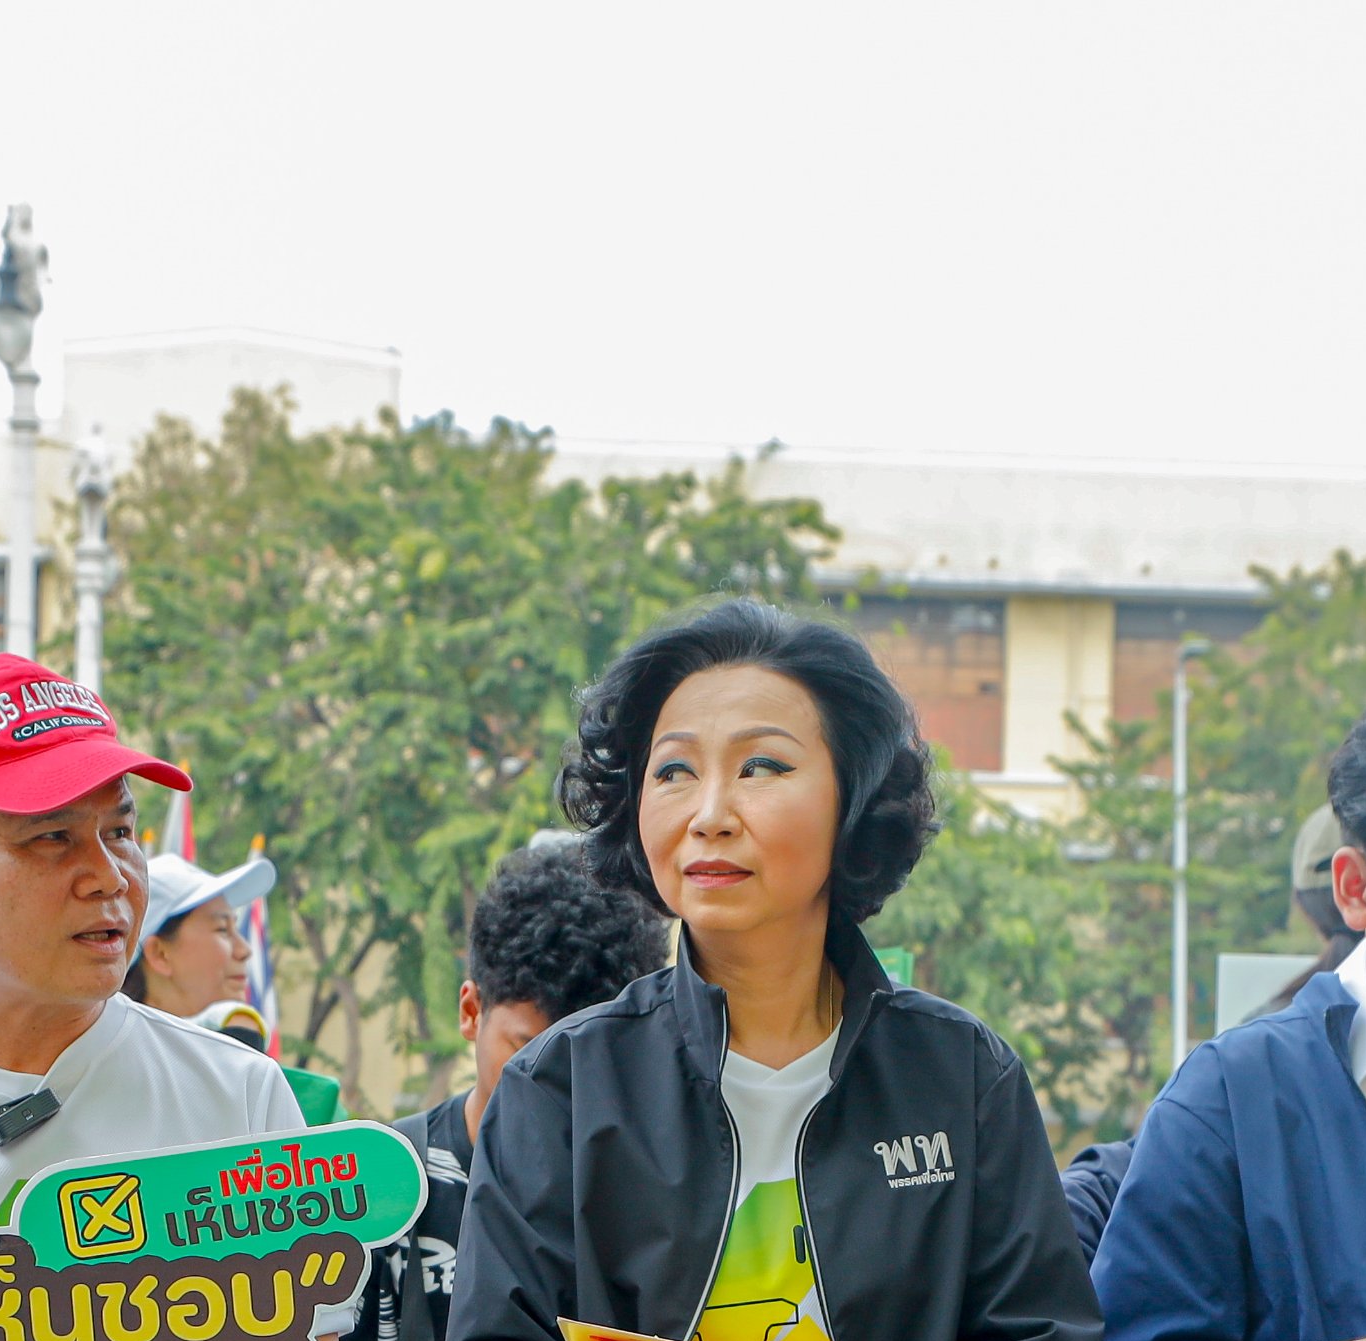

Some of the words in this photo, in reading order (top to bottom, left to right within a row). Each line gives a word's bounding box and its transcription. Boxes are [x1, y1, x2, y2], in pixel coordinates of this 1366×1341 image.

[21, 680, 111, 721] ANGELES
[19, 716, 101, 737] CALIFORNIA
[220, 1143, 358, 1197] เพื่อไทย
[873, 1131, 954, 1176] พท
[165, 1184, 367, 1246] เห็นชอบ
